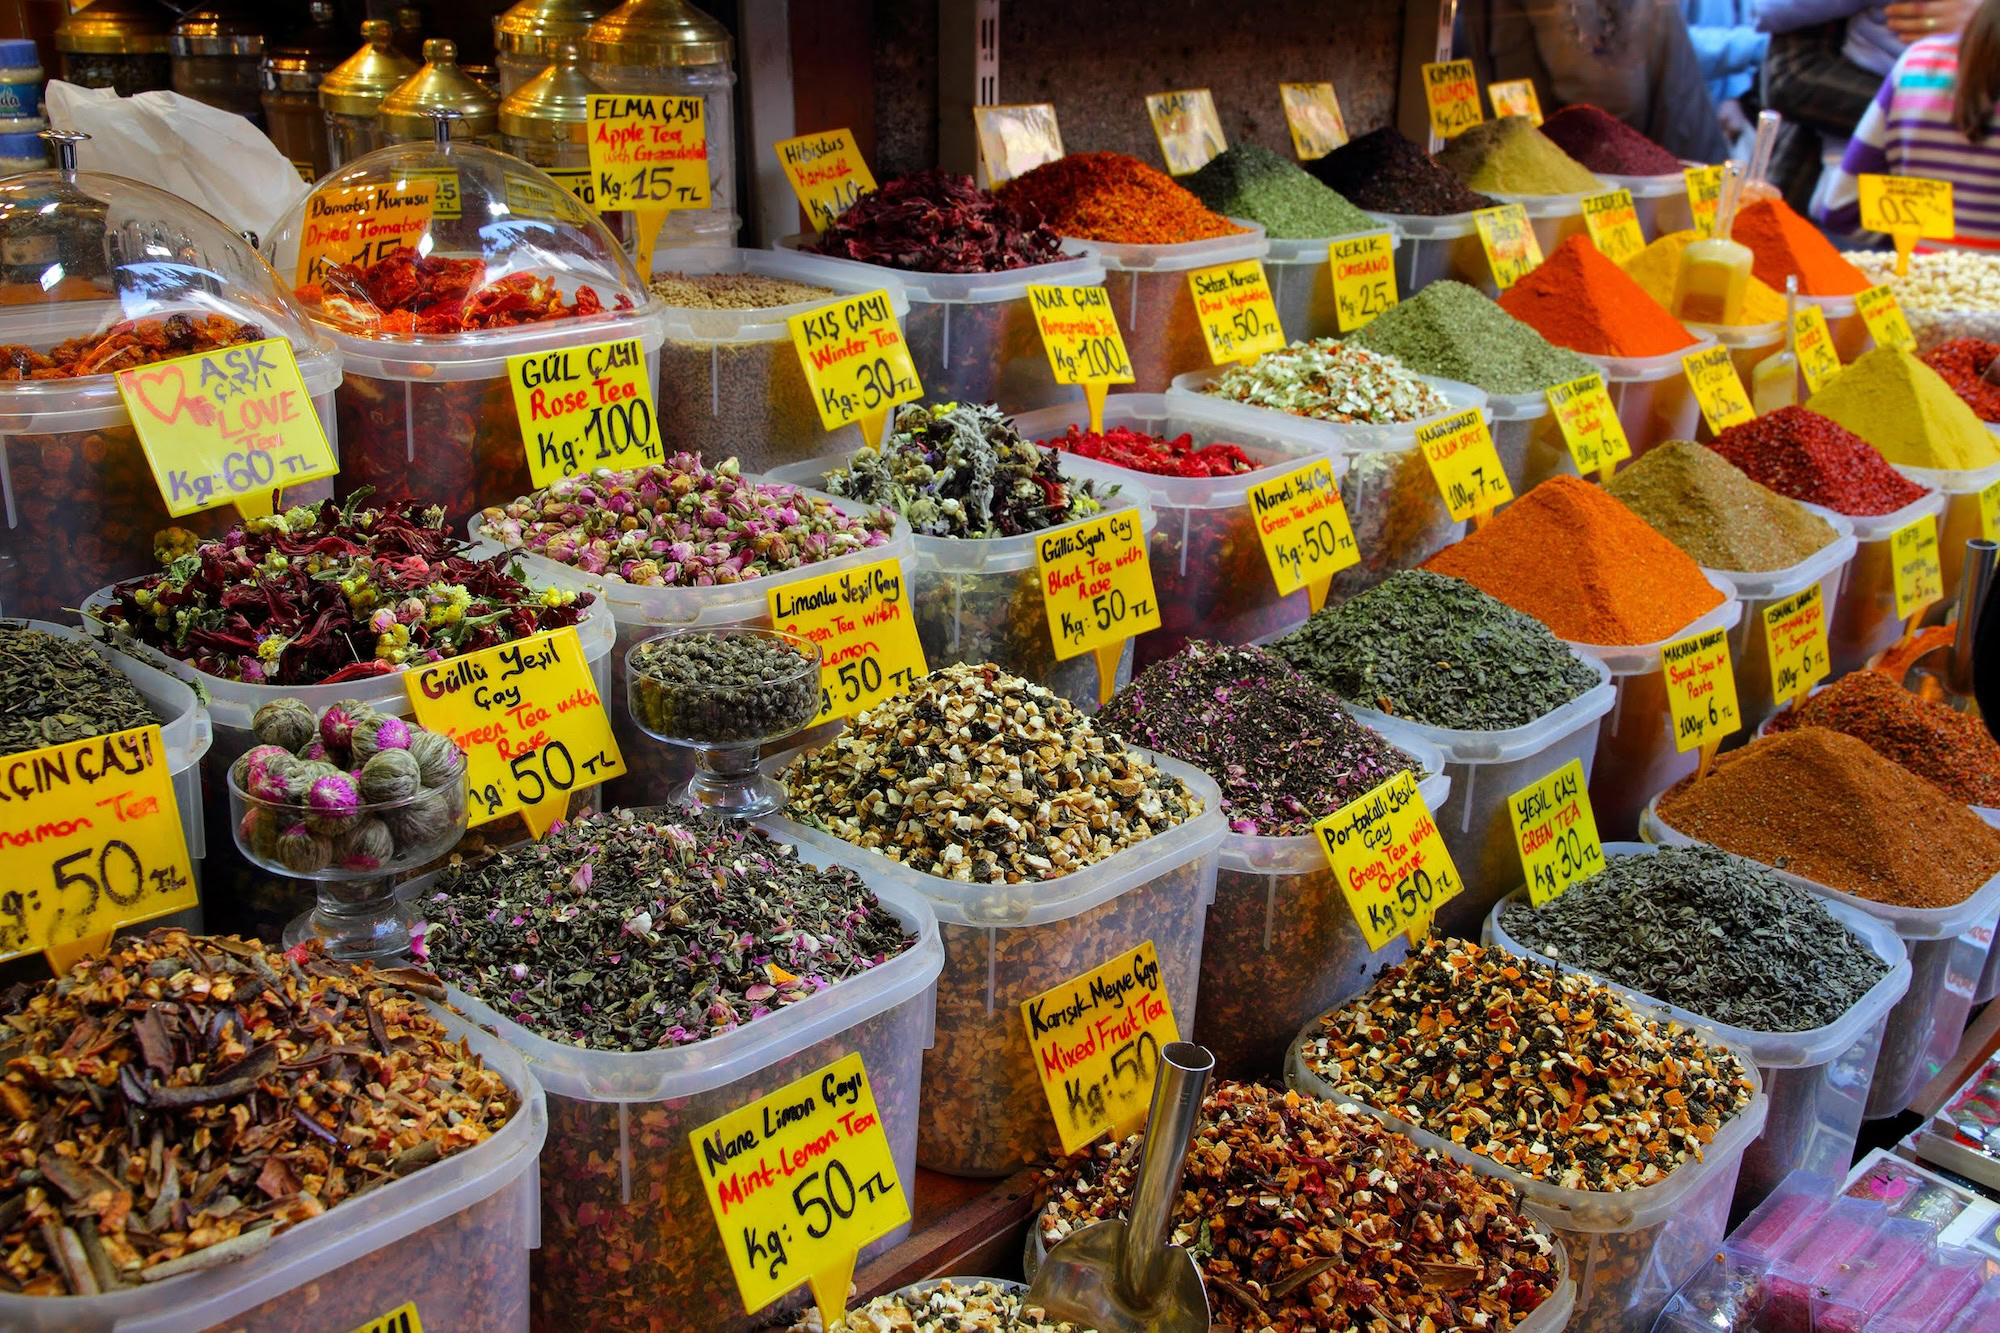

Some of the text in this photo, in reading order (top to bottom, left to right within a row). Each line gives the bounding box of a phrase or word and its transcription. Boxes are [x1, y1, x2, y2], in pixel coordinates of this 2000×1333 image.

[594, 98, 699, 124] ELMA ÇAYI
[1453, 102, 1471, 126] 20
[595, 122, 682, 150] Apple Tea
[603, 147, 631, 164] with
[785, 138, 845, 164] Hibiskus
[312, 189, 429, 219] Domates Kurusu
[601, 166, 703, 206] Kg: 15 TL
[307, 219, 351, 247] Dried
[1033, 288, 1106, 312] NAR ÇAYI
[1195, 270, 1261, 295] Sebze Kurusu
[1359, 281, 1388, 316] 25
[803, 295, 889, 346] KIŞ ÇAYI
[1199, 297, 1224, 315] Dried
[810, 328, 898, 372] Winter Tea
[1210, 307, 1278, 355] Kg: 50 TL
[200, 345, 277, 388] AŞK
[522, 341, 639, 389] GÜL ÇAYI
[1053, 337, 1121, 383] Kg: 100
[214, 372, 272, 404] ÇAYI
[530, 378, 637, 421] Rose Tea
[822, 357, 917, 420] Kg: 30 TL
[217, 390, 300, 440] LOVE
[234, 432, 285, 453] Tea
[537, 398, 661, 477] Kg: 100 TL
[1601, 428, 1613, 456] 6
[168, 450, 319, 507] Kg: 60 TL
[1254, 483, 1293, 515] Naneli
[1471, 467, 1504, 496] 7 TL
[1261, 515, 1291, 535] Green
[1289, 506, 1305, 519] Tea
[1306, 497, 1324, 514] with
[1042, 518, 1133, 563] Güllü Siyah Çay
[1275, 520, 1353, 580] Kg: 50 TL
[1048, 546, 1142, 596] Black Tea with
[1079, 578, 1111, 600] Rose
[776, 585, 838, 619] Limonlu
[840, 572, 873, 603] Yeşil
[1061, 588, 1154, 645] Kg: 50 TL
[783, 601, 900, 646] Green Tea with
[420, 638, 561, 700] Güllü Yeşil
[820, 641, 880, 668] Lemon
[1803, 645, 1824, 674] 6 TL
[474, 685, 521, 711] Çay
[838, 656, 921, 702] 50 TL
[1687, 679, 1713, 701] Pasta
[505, 702, 552, 731] Tea
[557, 688, 600, 714] with
[1708, 696, 1733, 726] 6 TL
[76, 731, 153, 784] ÇAYI
[496, 730, 552, 762] Rose
[510, 740, 616, 805] 50 TL
[1387, 775, 1416, 813] Yeşil
[96, 790, 160, 822] Tea
[1518, 772, 1577, 830] YEŞİL ÇAY
[1363, 821, 1392, 850] Çay
[1522, 800, 1582, 856] GREEN TEA
[1349, 815, 1435, 892] Green Tea with
[1378, 850, 1427, 893] Orange
[1534, 828, 1600, 896] Kg: 30 TL
[52, 839, 187, 921] 50 TL
[1367, 869, 1453, 938] Kg: 50 TL
[1089, 972, 1135, 1009] Meyve
[1134, 954, 1159, 991] Çayı
[1041, 993, 1168, 1081] Mixed Fruit Tea
[1064, 1031, 1159, 1131] Kg: 50
[703, 1072, 862, 1177] Nane Limon Çayı
[717, 1110, 876, 1215] Mint-Lemon Tea
[743, 1159, 895, 1280] Kg: 50 TL
